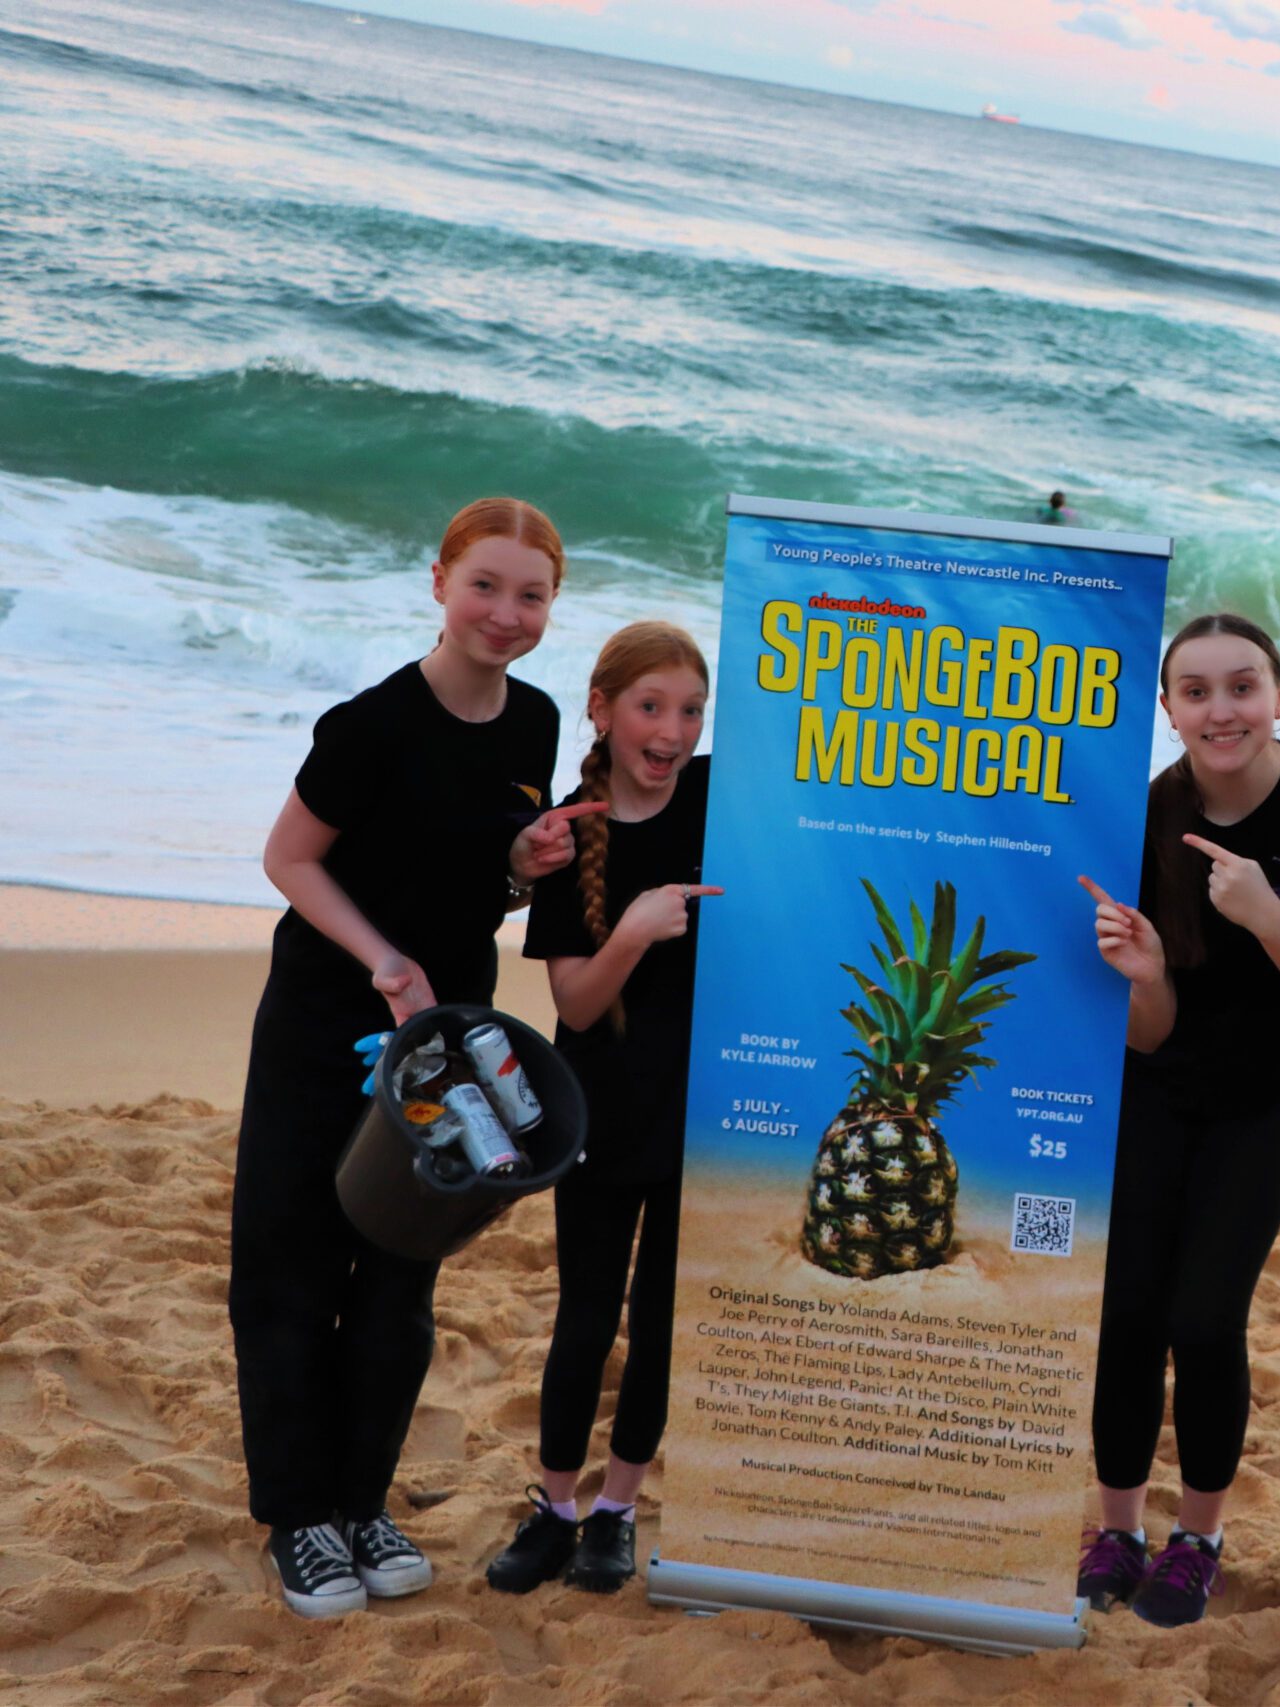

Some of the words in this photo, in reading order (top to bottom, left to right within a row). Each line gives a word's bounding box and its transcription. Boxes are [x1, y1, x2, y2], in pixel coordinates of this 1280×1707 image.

[773, 543, 819, 563] Young
[823, 550, 882, 567] People's
[887, 555, 942, 572] Theatre
[946, 561, 1020, 580] Newcastle
[1024, 569, 1049, 582] Inc.
[809, 592, 926, 619] nickelodeon
[848, 618, 878, 634] THE
[757, 599, 1121, 728] SPONGEBOB
[795, 706, 1070, 803] MUSICAL
[798, 816, 834, 831] Based
[837, 822, 852, 832] on
[856, 823, 875, 835] the
[879, 827, 912, 839] series
[915, 830, 930, 843] by
[936, 831, 986, 847] Stephen
[990, 837, 1051, 856] Hillenberg
[721, 1048, 755, 1062] KYLE
[758, 1053, 816, 1069] JARROW
[741, 1033, 779, 1048] BOOK
[782, 1038, 800, 1050] BY
[732, 1100, 742, 1111] 5
[745, 1100, 781, 1115] JULY
[1011, 1087, 1044, 1100] BOOK
[1047, 1091, 1094, 1105] TICKETS
[1016, 1108, 1083, 1123] YPT.ORG.AU
[721, 1118, 731, 1129] 6
[735, 1119, 799, 1136] AUGUST
[1030, 1133, 1067, 1159] $25
[710, 1286, 768, 1305] Original
[772, 1294, 815, 1311] Songs
[819, 1300, 836, 1315] by
[840, 1302, 896, 1321] Yolanda
[957, 1317, 1006, 1332] Steven
[1010, 1322, 1045, 1339] Tyler
[1050, 1329, 1076, 1342] and
[720, 1307, 744, 1321] Joe
[748, 1310, 786, 1328] Perry
[791, 1315, 804, 1327] of
[808, 1318, 887, 1340] Aerosmith,
[891, 1328, 922, 1343] Sara
[927, 1332, 993, 1353] Bareilles,
[998, 1340, 1063, 1359] Jonathan
[697, 1323, 757, 1342] Coulton,
[761, 1331, 791, 1346] Alex
[796, 1335, 834, 1349] Ebert
[839, 1342, 853, 1352] of
[856, 1343, 912, 1361] Edward
[916, 1350, 966, 1368] Sharpe
[970, 1356, 980, 1369] &
[985, 1358, 1012, 1373] The
[1016, 1362, 1084, 1381] Magnetic
[716, 1344, 759, 1362] Zeros,
[765, 1350, 790, 1364] The
[795, 1354, 849, 1374] Flaming
[854, 1362, 885, 1377] Lips,
[890, 1367, 923, 1383] Lady
[1019, 1382, 1061, 1397] Cyndi
[699, 1362, 749, 1380] Lauper,
[753, 1369, 787, 1383] John
[791, 1373, 845, 1391] Legend,
[850, 1379, 892, 1396] Panic!
[897, 1386, 914, 1398] At
[919, 1388, 941, 1401] the
[993, 1397, 1028, 1412] Plain
[1032, 1402, 1077, 1418] White
[707, 1380, 730, 1395] T's,
[734, 1383, 773, 1400] They
[773, 1389, 813, 1406] Might
[818, 1394, 837, 1408] Be
[841, 1397, 890, 1416] Giants,
[917, 1407, 947, 1421] And
[951, 1412, 994, 1429] Songs
[998, 1417, 1015, 1432] by
[1023, 1420, 1065, 1436] David
[696, 1397, 743, 1415] Bowie,
[747, 1404, 776, 1419] Tom
[781, 1409, 825, 1428] Kenny
[829, 1416, 840, 1427] &
[843, 1417, 881, 1435] Andy
[886, 1422, 925, 1439] Paley.
[929, 1428, 1006, 1448] Additional
[1010, 1438, 1051, 1454] Lyrics
[1056, 1443, 1074, 1458] by
[712, 1419, 776, 1437] Jonathan
[780, 1428, 840, 1446] Coulton.
[844, 1436, 920, 1457] Additional
[924, 1447, 967, 1462] Music
[972, 1452, 989, 1466] by
[993, 1454, 1022, 1469] Tom
[1027, 1459, 1054, 1473] Kitt
[742, 1457, 786, 1473] Musical
[789, 1464, 852, 1482] Production
[855, 1473, 916, 1489] Conceived
[919, 1482, 933, 1493] by
[936, 1484, 960, 1496] Tina
[964, 1488, 1005, 1502] Landau
